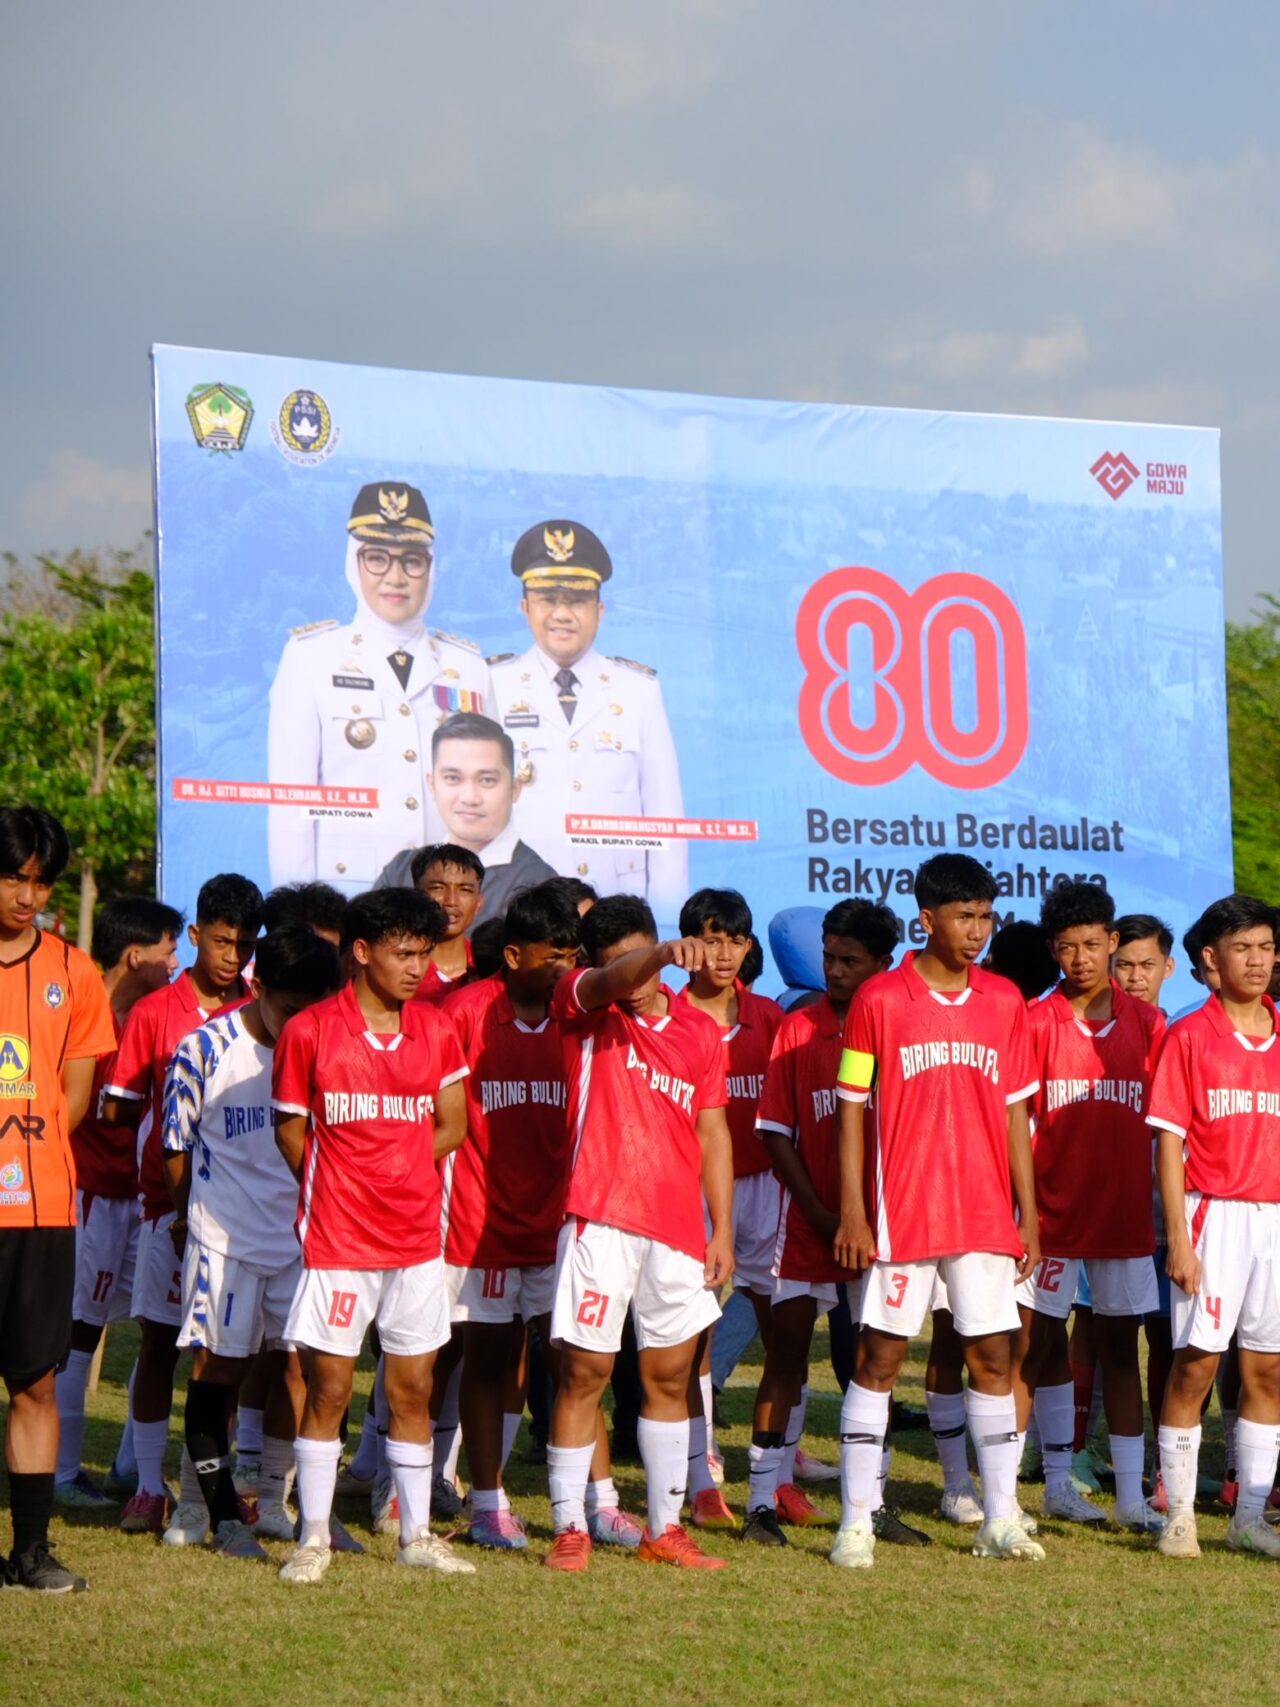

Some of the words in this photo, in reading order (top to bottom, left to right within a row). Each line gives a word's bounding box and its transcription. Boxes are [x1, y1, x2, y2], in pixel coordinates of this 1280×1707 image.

[1146, 462, 1187, 479] GOWA
[1146, 479, 1184, 495] MAJU
[795, 566, 1029, 790] 80
[309, 809, 342, 817] BUPATI
[806, 808, 946, 847] Bersatu
[956, 813, 1125, 851] Berdaulat
[570, 837, 600, 845] WAKIL
[602, 838, 633, 846] BUPATI
[635, 839, 663, 847] GOWA
[808, 857, 916, 900] Rakya
[985, 861, 1107, 897] ahtea
[899, 1041, 949, 1081] BIRING
[951, 1041, 986, 1069] BULU
[984, 1047, 999, 1085] FC
[481, 1080, 527, 1115] BIRING
[530, 1080, 560, 1107] BULU
[726, 1074, 757, 1098] BULU
[1046, 1079, 1089, 1112] BIRING
[1094, 1080, 1127, 1105] BULU
[1128, 1080, 1143, 1113] FC
[324, 1092, 378, 1125] BIRING
[382, 1094, 416, 1123] BULU
[812, 1088, 837, 1123] BIRI
[1207, 1089, 1252, 1121] BIRING
[223, 1106, 265, 1140] BIRING
[92, 1270, 113, 1302] 17
[482, 1268, 508, 1299] 10
[885, 1272, 909, 1309] 3
[1037, 1257, 1066, 1293] 12
[224, 1292, 234, 1327] 1
[327, 1290, 358, 1328] 19
[577, 1289, 610, 1328] 21
[1206, 1296, 1222, 1330] 4
